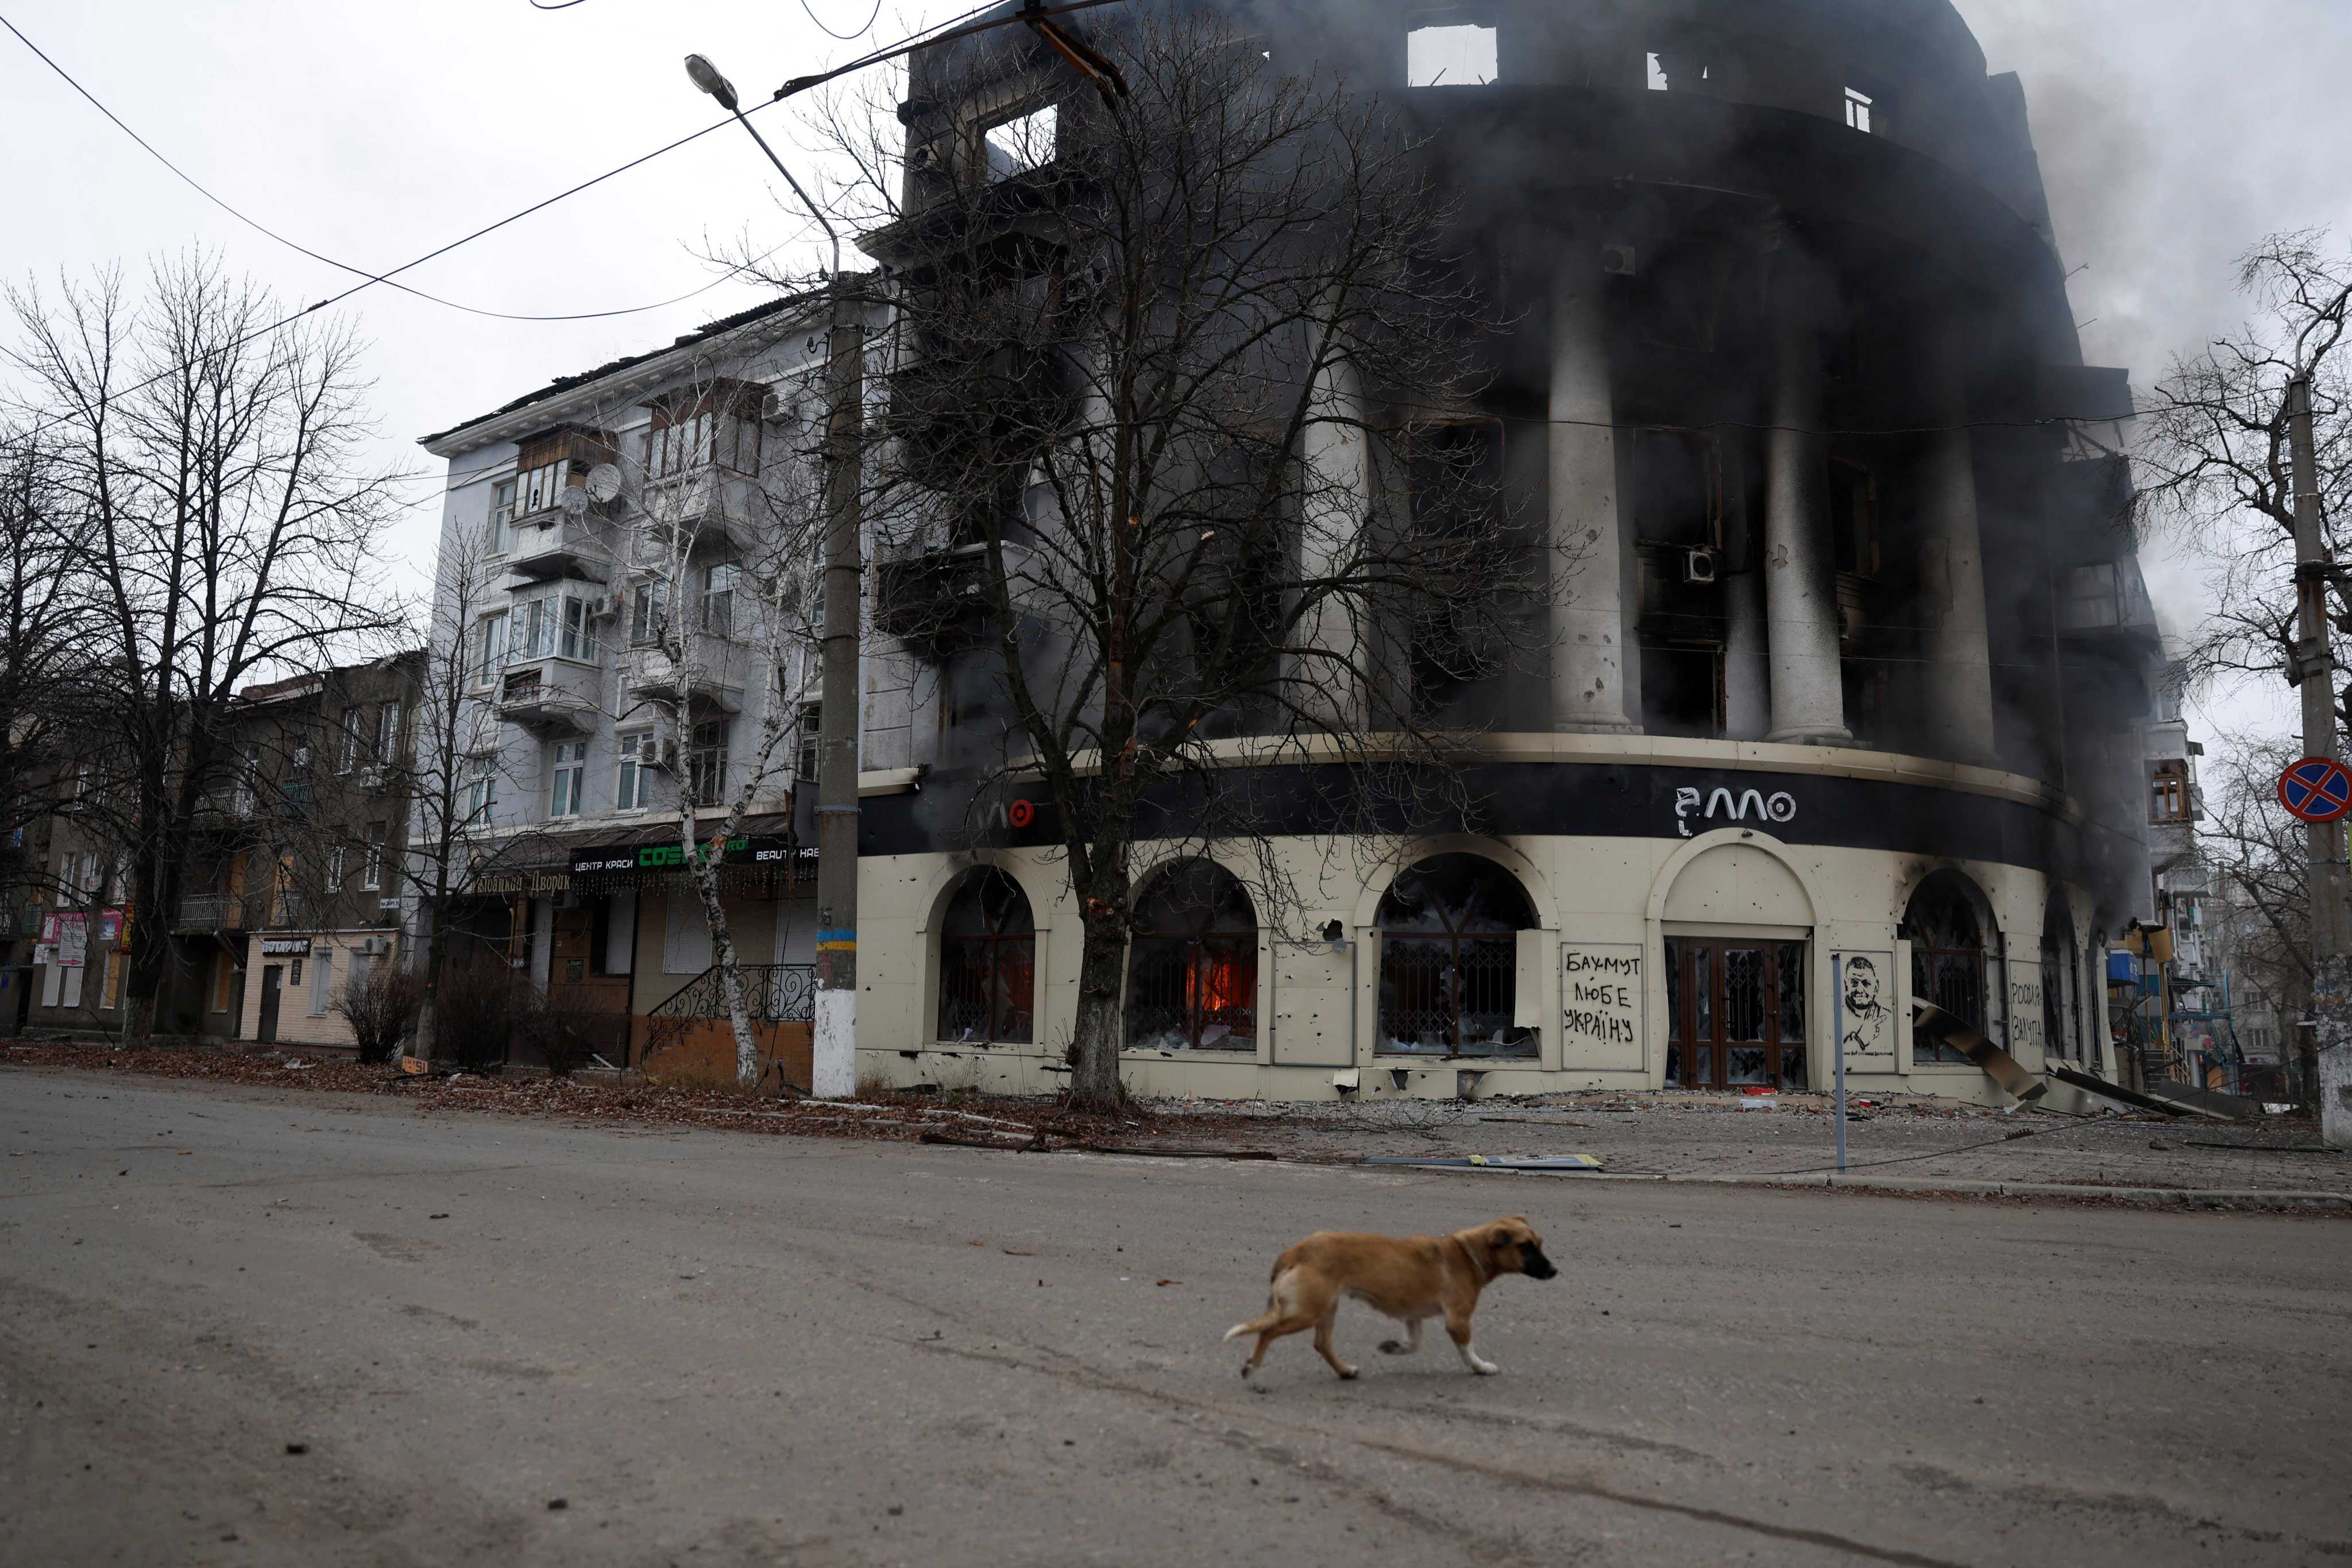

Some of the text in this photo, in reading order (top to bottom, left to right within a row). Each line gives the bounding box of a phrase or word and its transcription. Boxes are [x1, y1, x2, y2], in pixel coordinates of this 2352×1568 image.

[575, 859, 633, 872] ЦЕНТР КРАСИ
[528, 870, 570, 897] Дворик
[1566, 952, 1640, 976] БАХМУТ
[1575, 982, 1632, 1008] ЛЮБЕ
[1564, 1009, 1633, 1043] УКРАЇНУ
[2013, 1015, 2042, 1048] ЗАЛУПА
